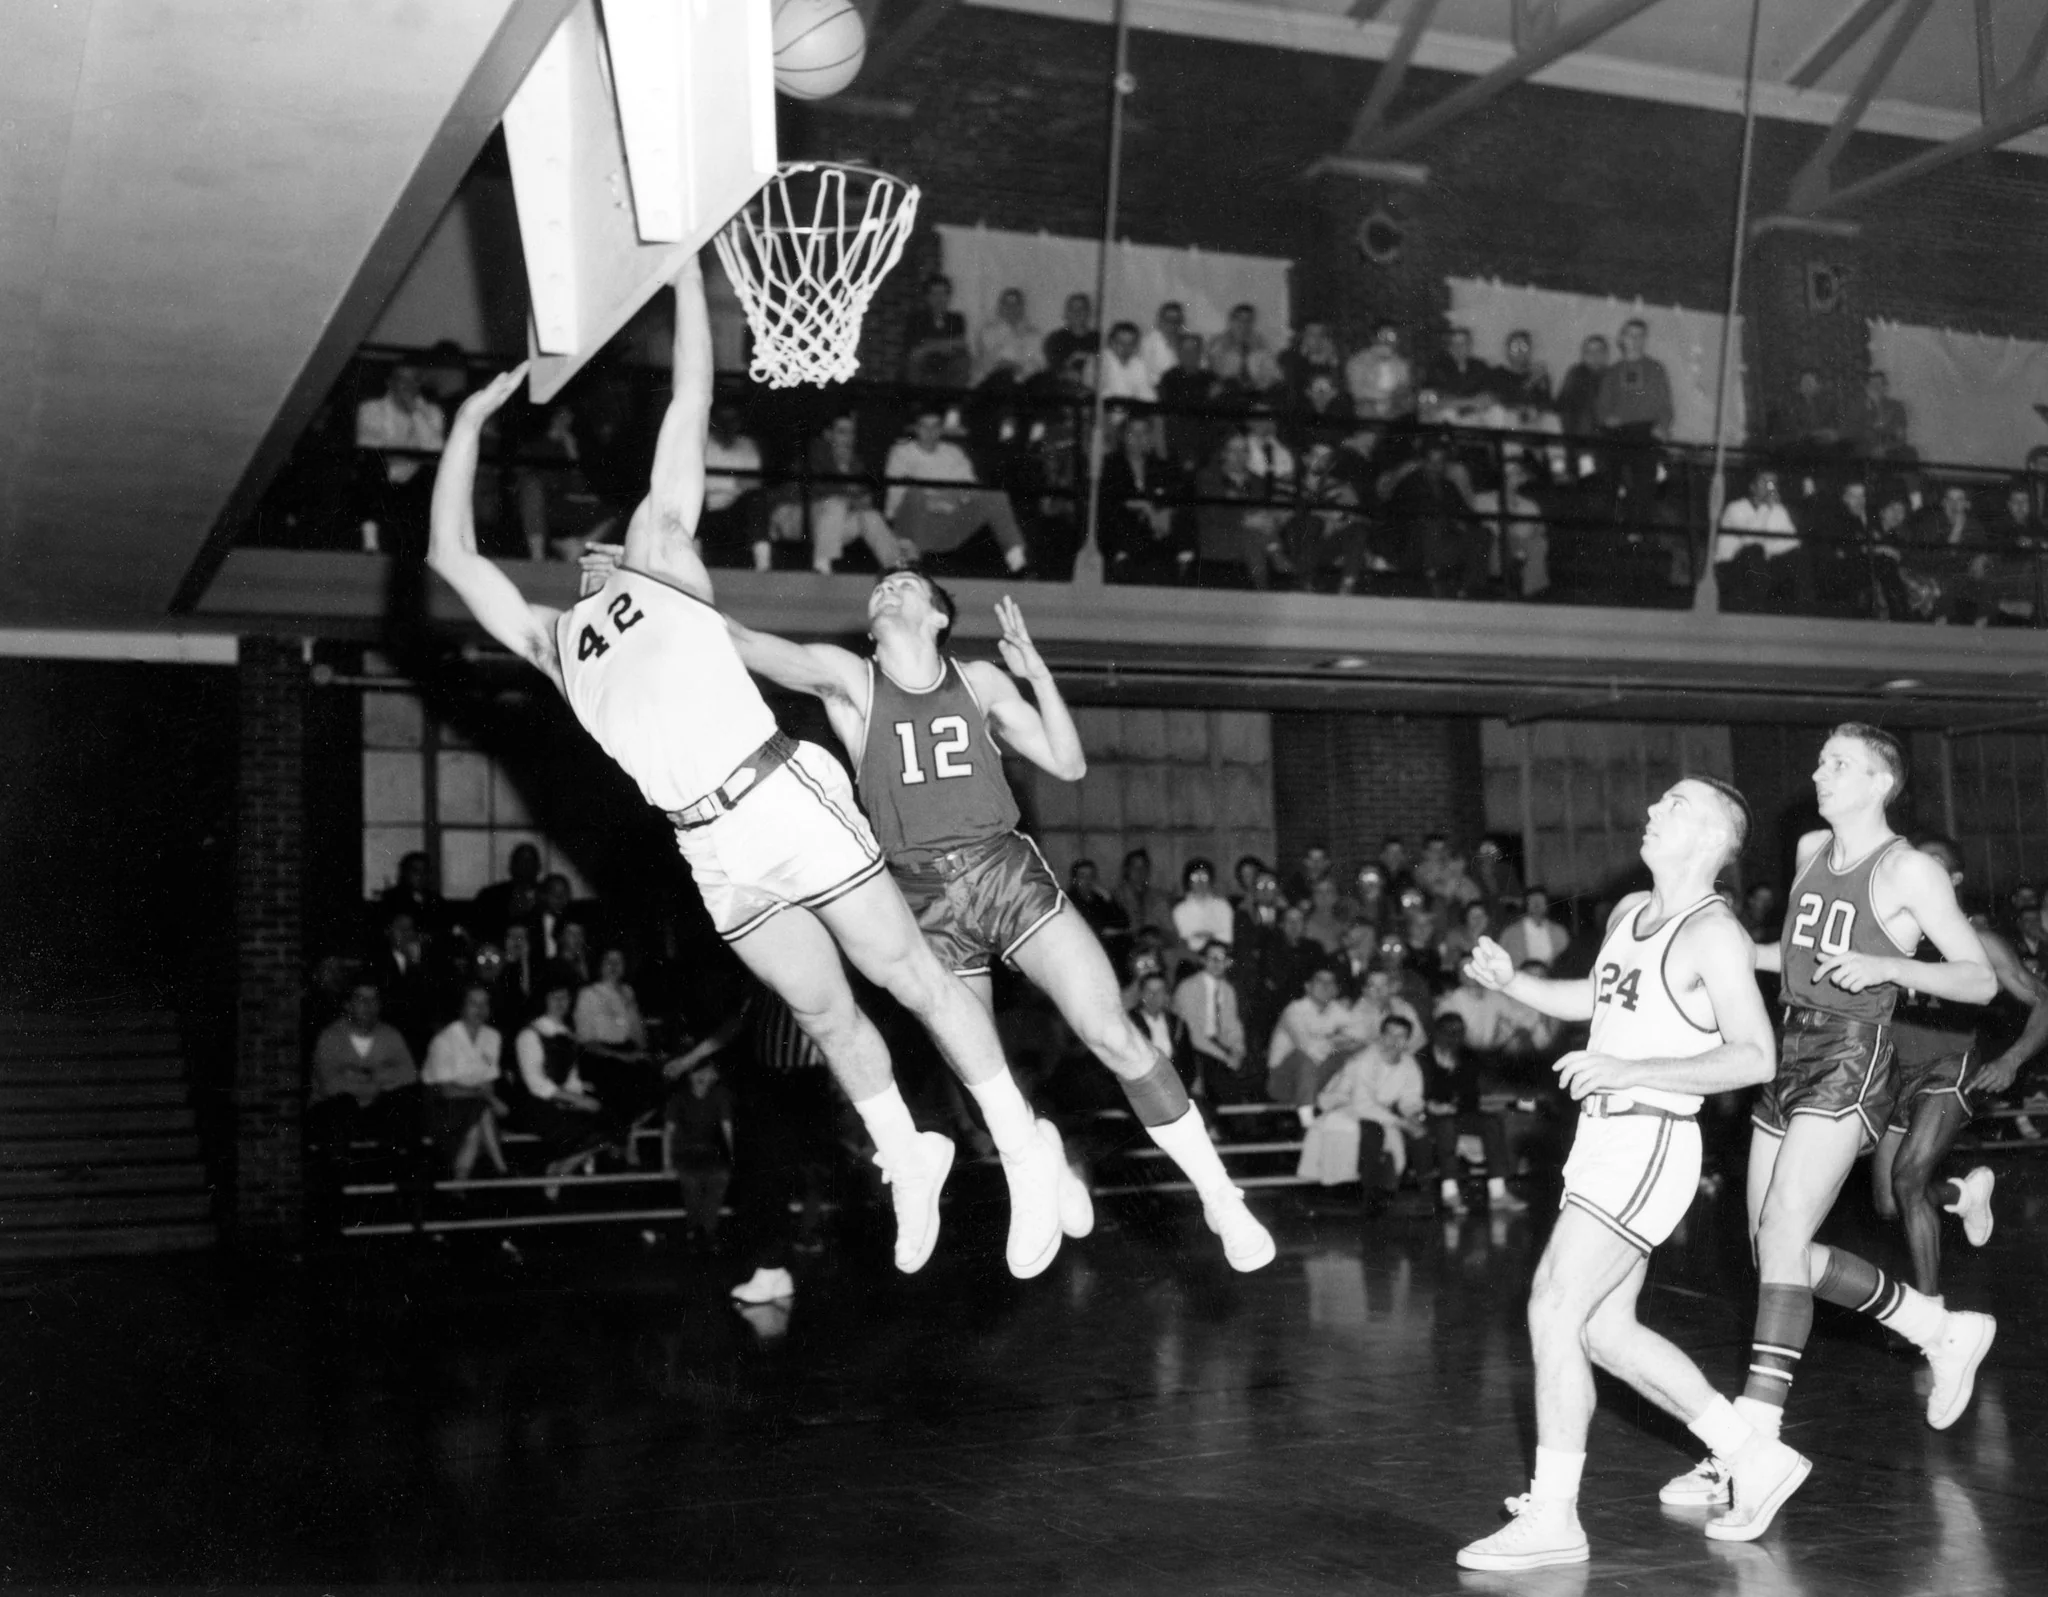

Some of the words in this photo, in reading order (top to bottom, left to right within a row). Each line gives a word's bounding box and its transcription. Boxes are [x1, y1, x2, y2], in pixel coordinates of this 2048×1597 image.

[578, 592, 645, 661] 42
[893, 714, 973, 785] 12
[1791, 892, 1857, 955] 20
[1598, 962, 1642, 1012] 24
